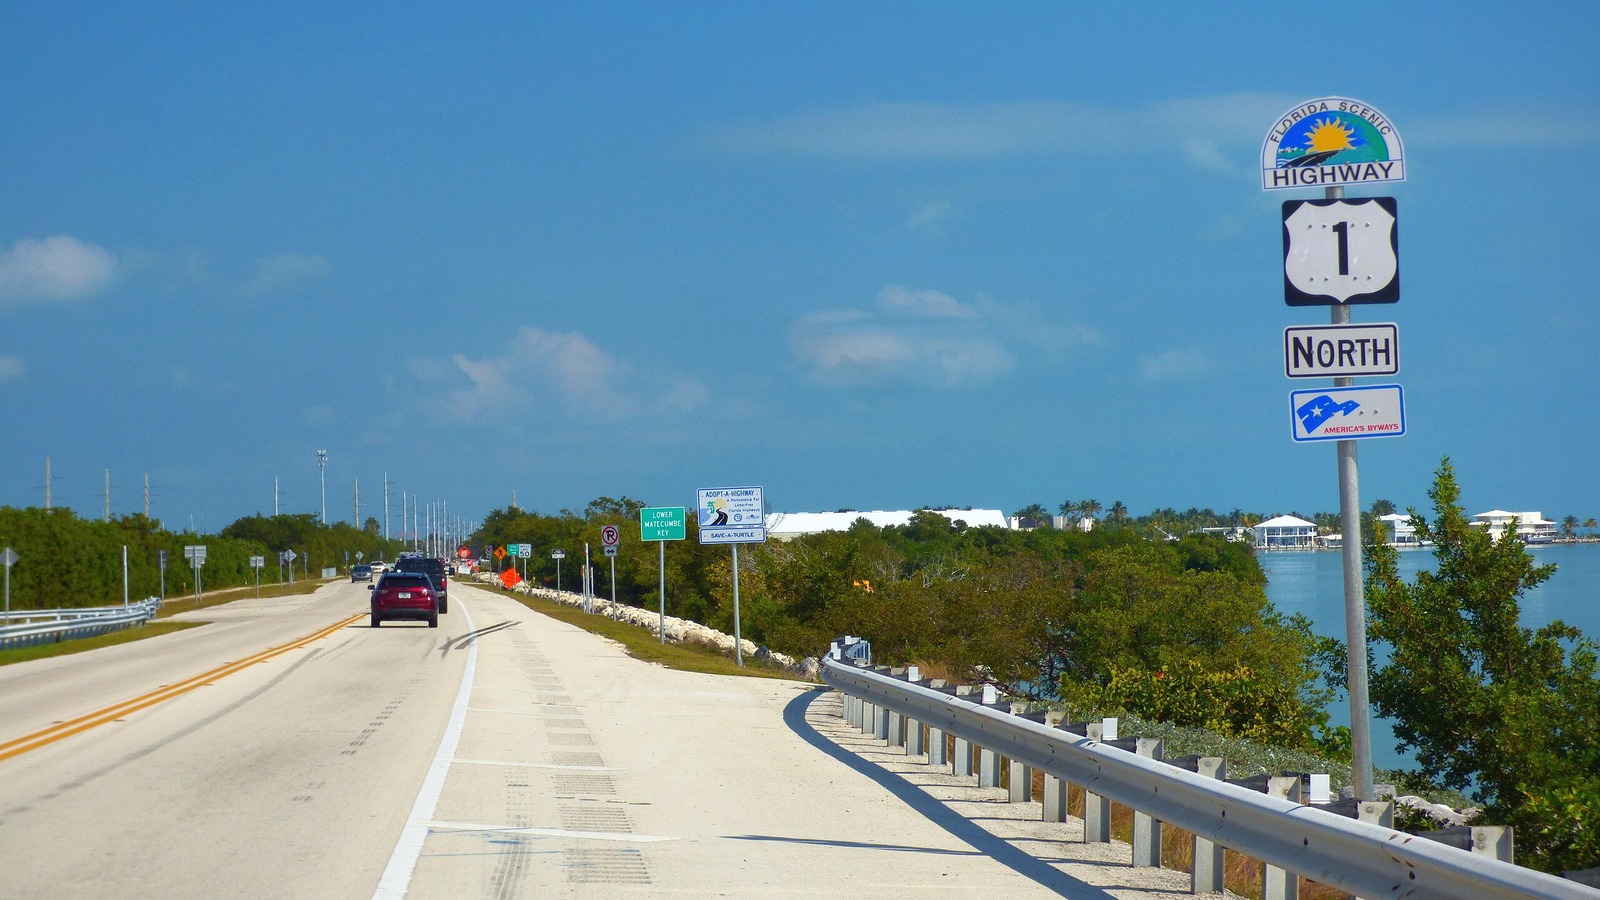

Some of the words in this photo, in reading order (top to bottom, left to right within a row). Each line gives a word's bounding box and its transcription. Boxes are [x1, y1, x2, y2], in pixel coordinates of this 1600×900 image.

[1270, 102, 1328, 143] FLORIDA
[1338, 101, 1391, 136] SCENIC
[1273, 162, 1394, 187] HIGHWAY
[1332, 221, 1349, 276] 1
[1293, 336, 1391, 369] NORTH
[1324, 425, 1365, 434] AMERICA'S
[1367, 423, 1399, 432] BYWAYS
[705, 489, 755, 498] ADOPT-A-HIGHWAY
[652, 511, 673, 519] LOWER
[644, 520, 682, 528] MATECUMBE
[657, 529, 669, 537] KEY
